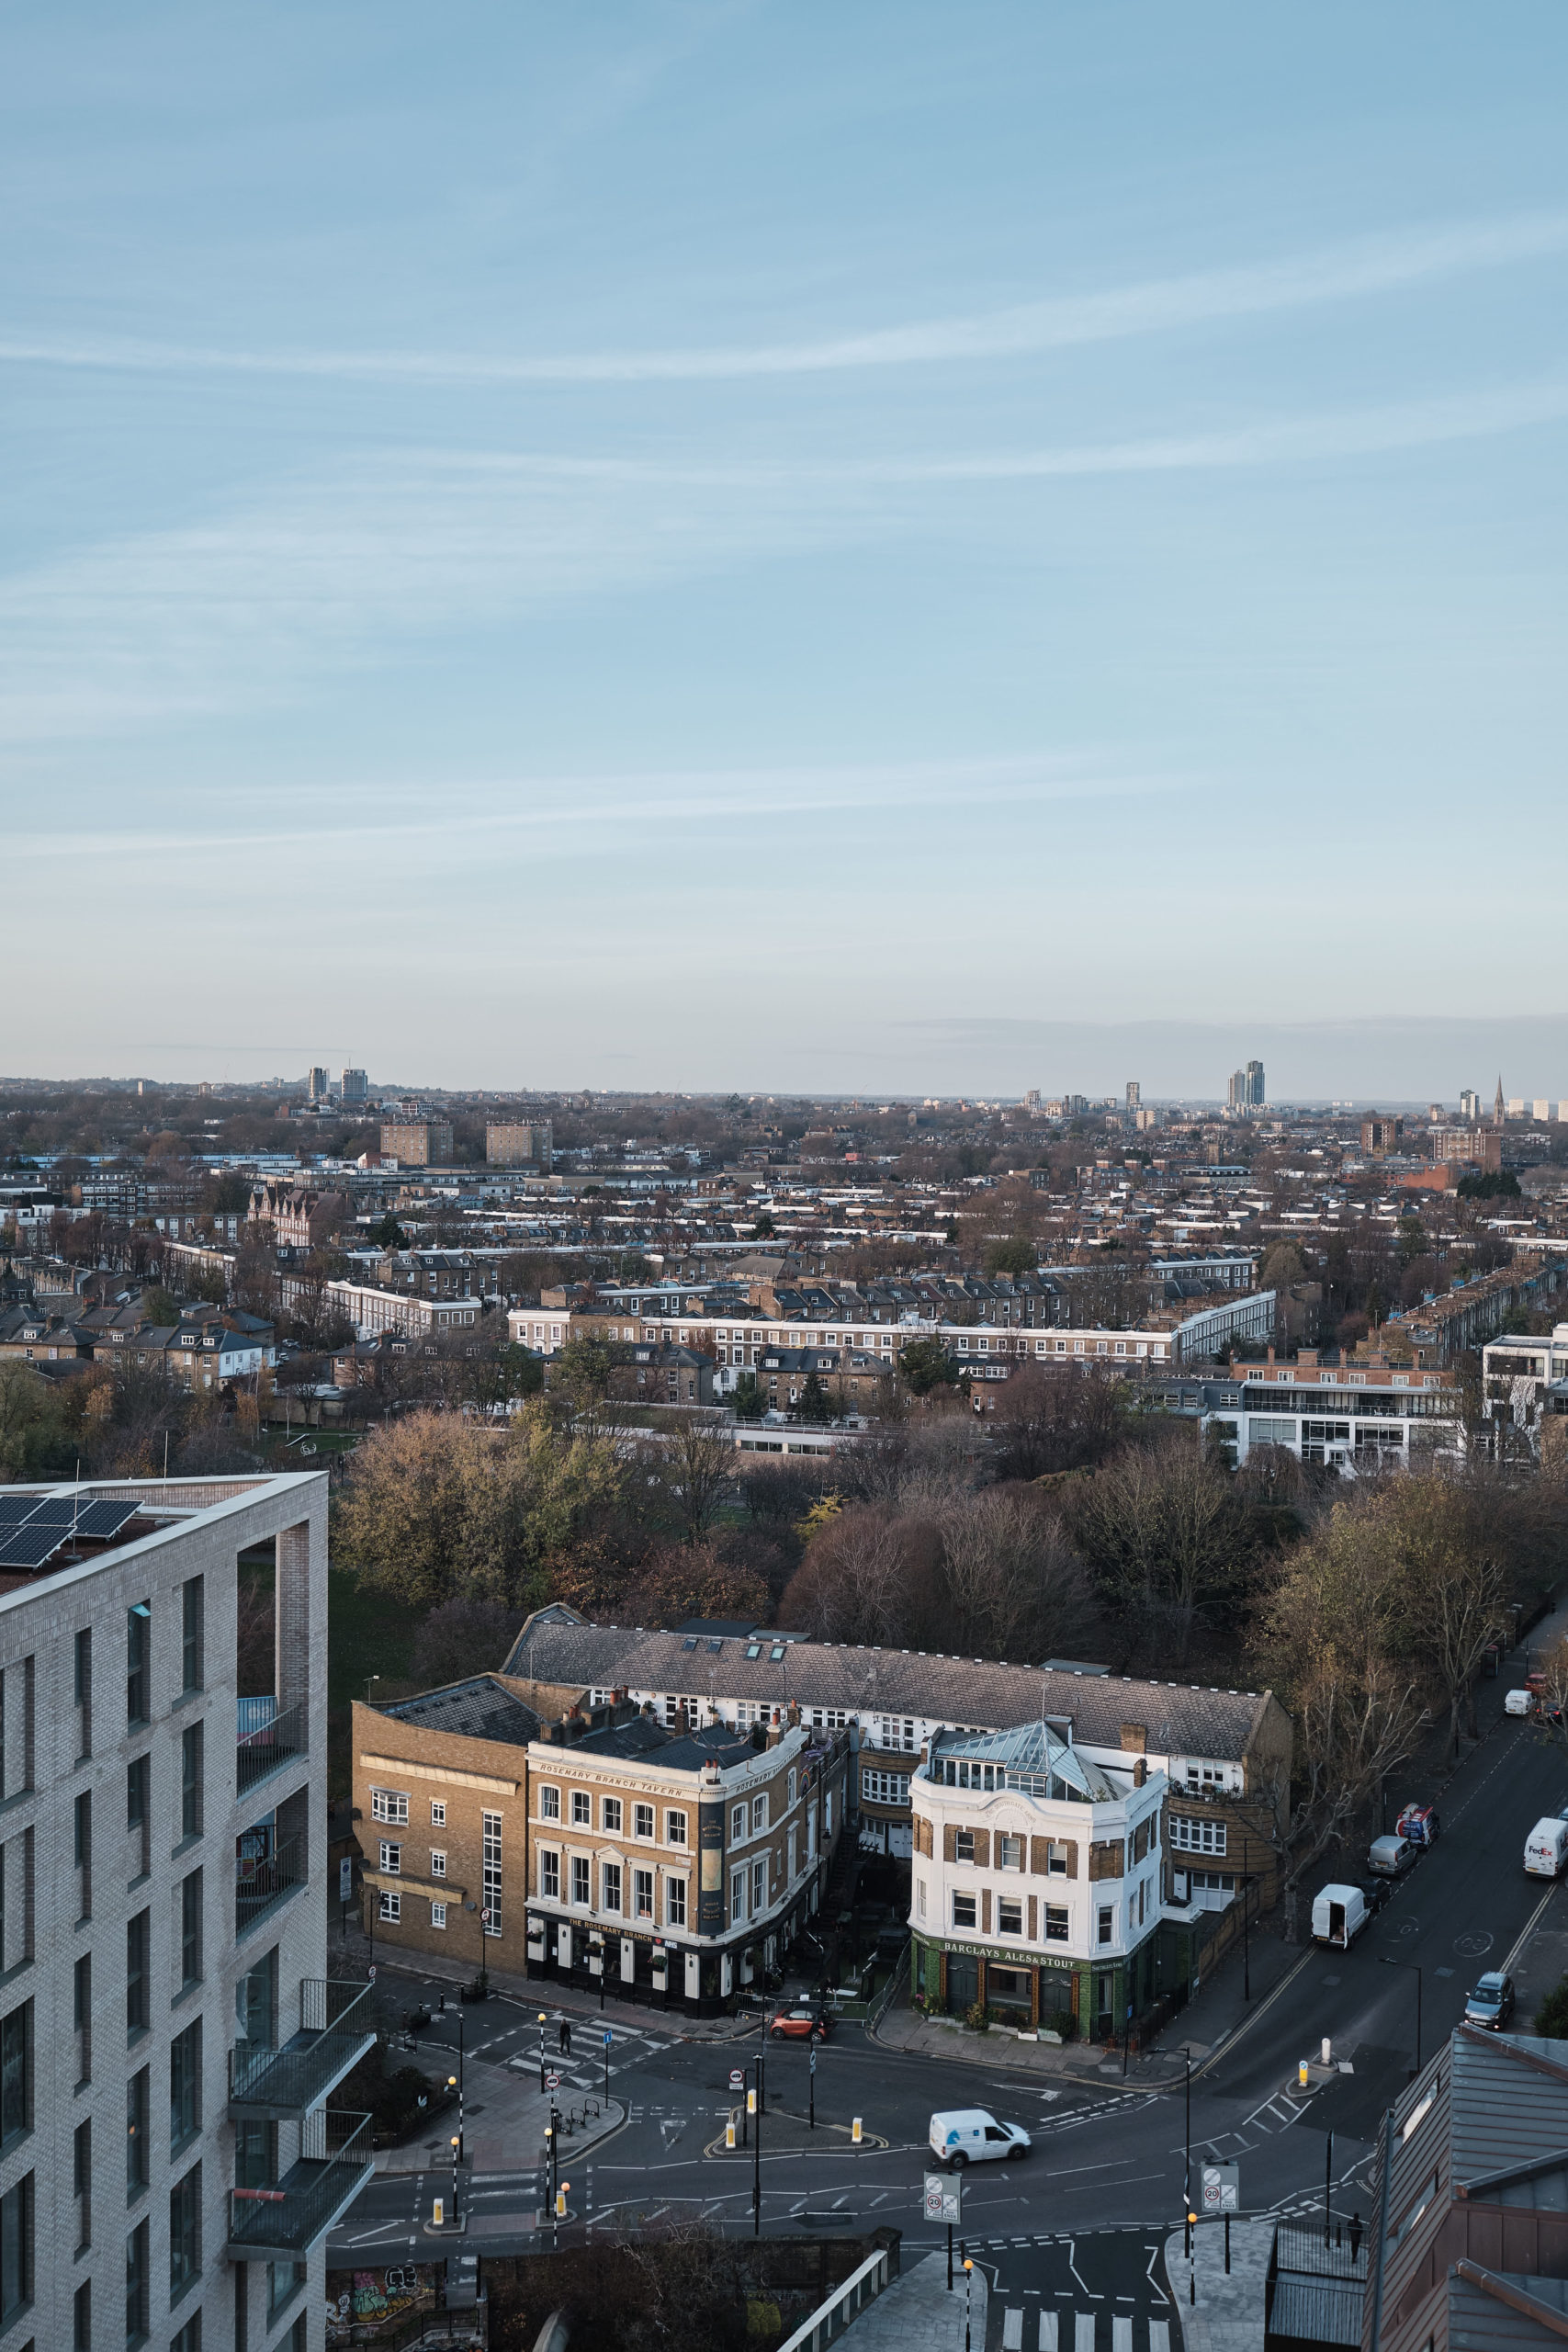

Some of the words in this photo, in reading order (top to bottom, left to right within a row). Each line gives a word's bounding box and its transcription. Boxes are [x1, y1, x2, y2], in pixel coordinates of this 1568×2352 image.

[540, 1764, 591, 1780] ROSEMARY
[596, 1775, 637, 1789] BRANCH
[736, 1771, 772, 1793] ROSEMARY
[1529, 1845, 1552, 1856] FedEx
[570, 1917, 581, 1927] THE
[584, 1921, 622, 1936] ROSEMARY
[624, 1930, 653, 1943] BRANCH
[944, 1942, 1000, 1958] BARCLAYS
